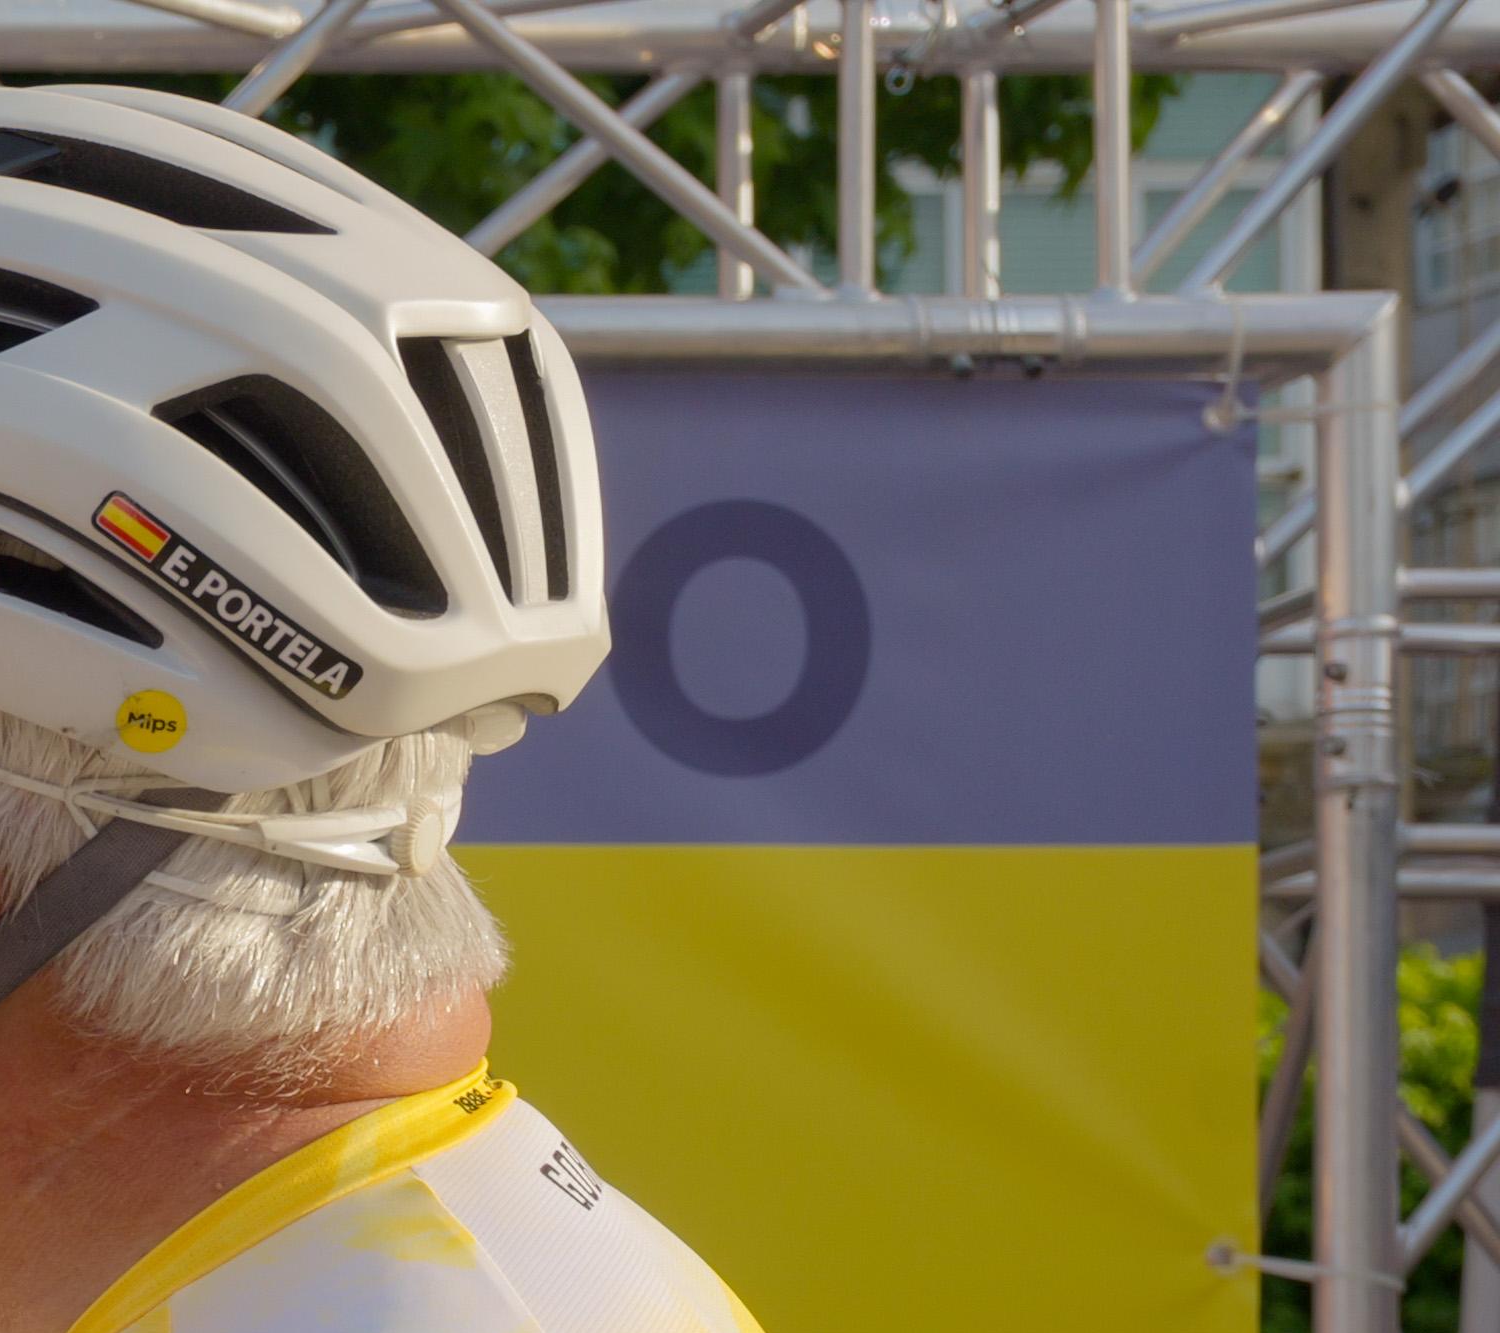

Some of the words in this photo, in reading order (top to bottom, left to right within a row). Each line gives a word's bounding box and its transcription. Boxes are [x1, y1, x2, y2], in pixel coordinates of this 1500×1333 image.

[160, 544, 197, 588] E.
[192, 569, 350, 696] PORTELA
[127, 711, 177, 734] Mips
